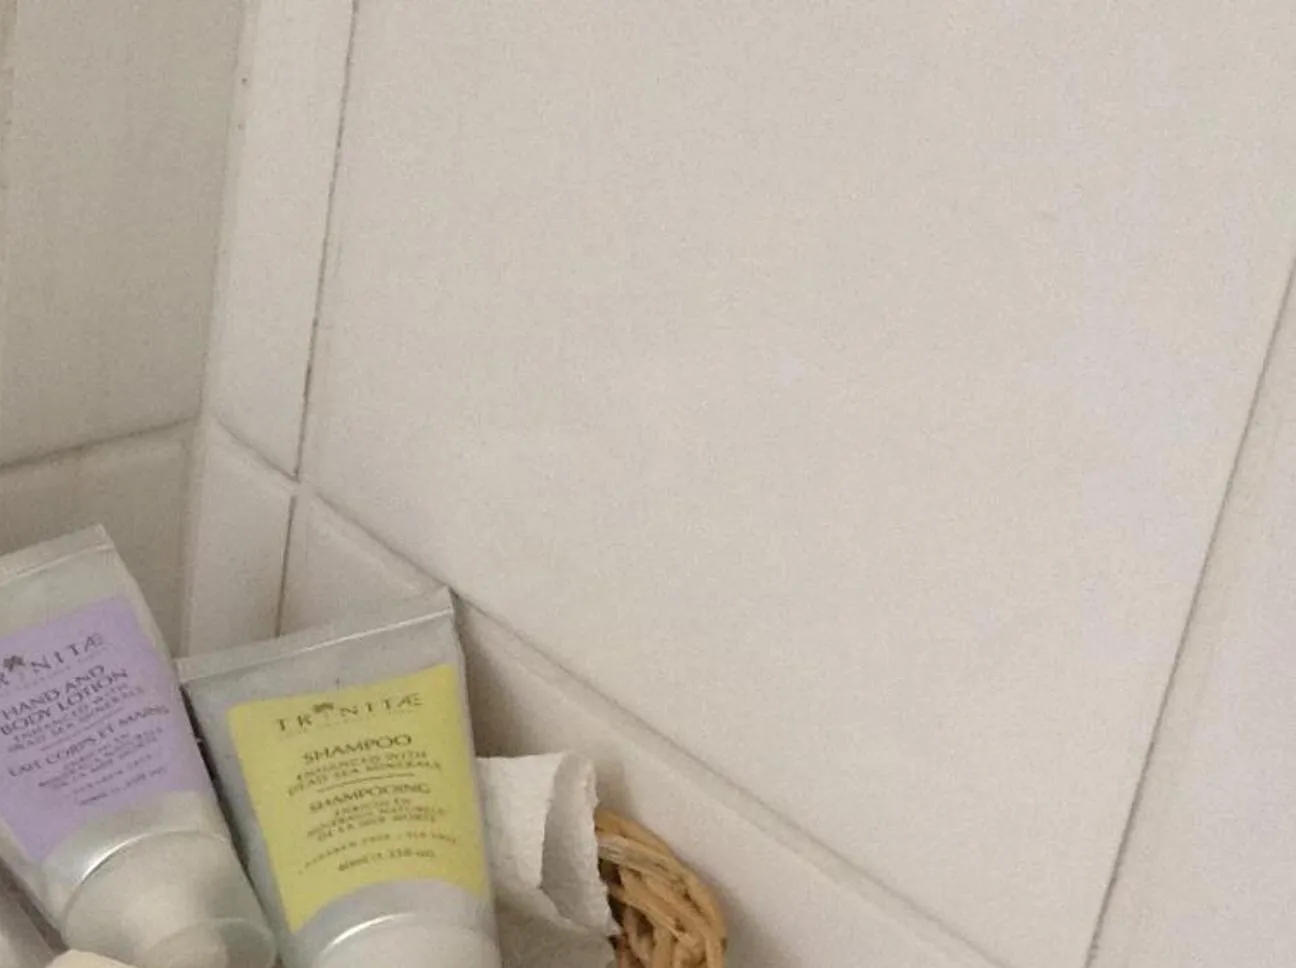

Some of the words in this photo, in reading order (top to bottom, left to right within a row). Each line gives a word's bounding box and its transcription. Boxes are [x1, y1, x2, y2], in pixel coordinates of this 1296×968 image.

[0, 707, 51, 735] BODY
[57, 669, 128, 711] LOTION
[1, 687, 61, 721] HAND
[65, 665, 104, 693] AND
[302, 734, 412, 764] SHAMPOO
[309, 783, 431, 812] SHAMPOOING
